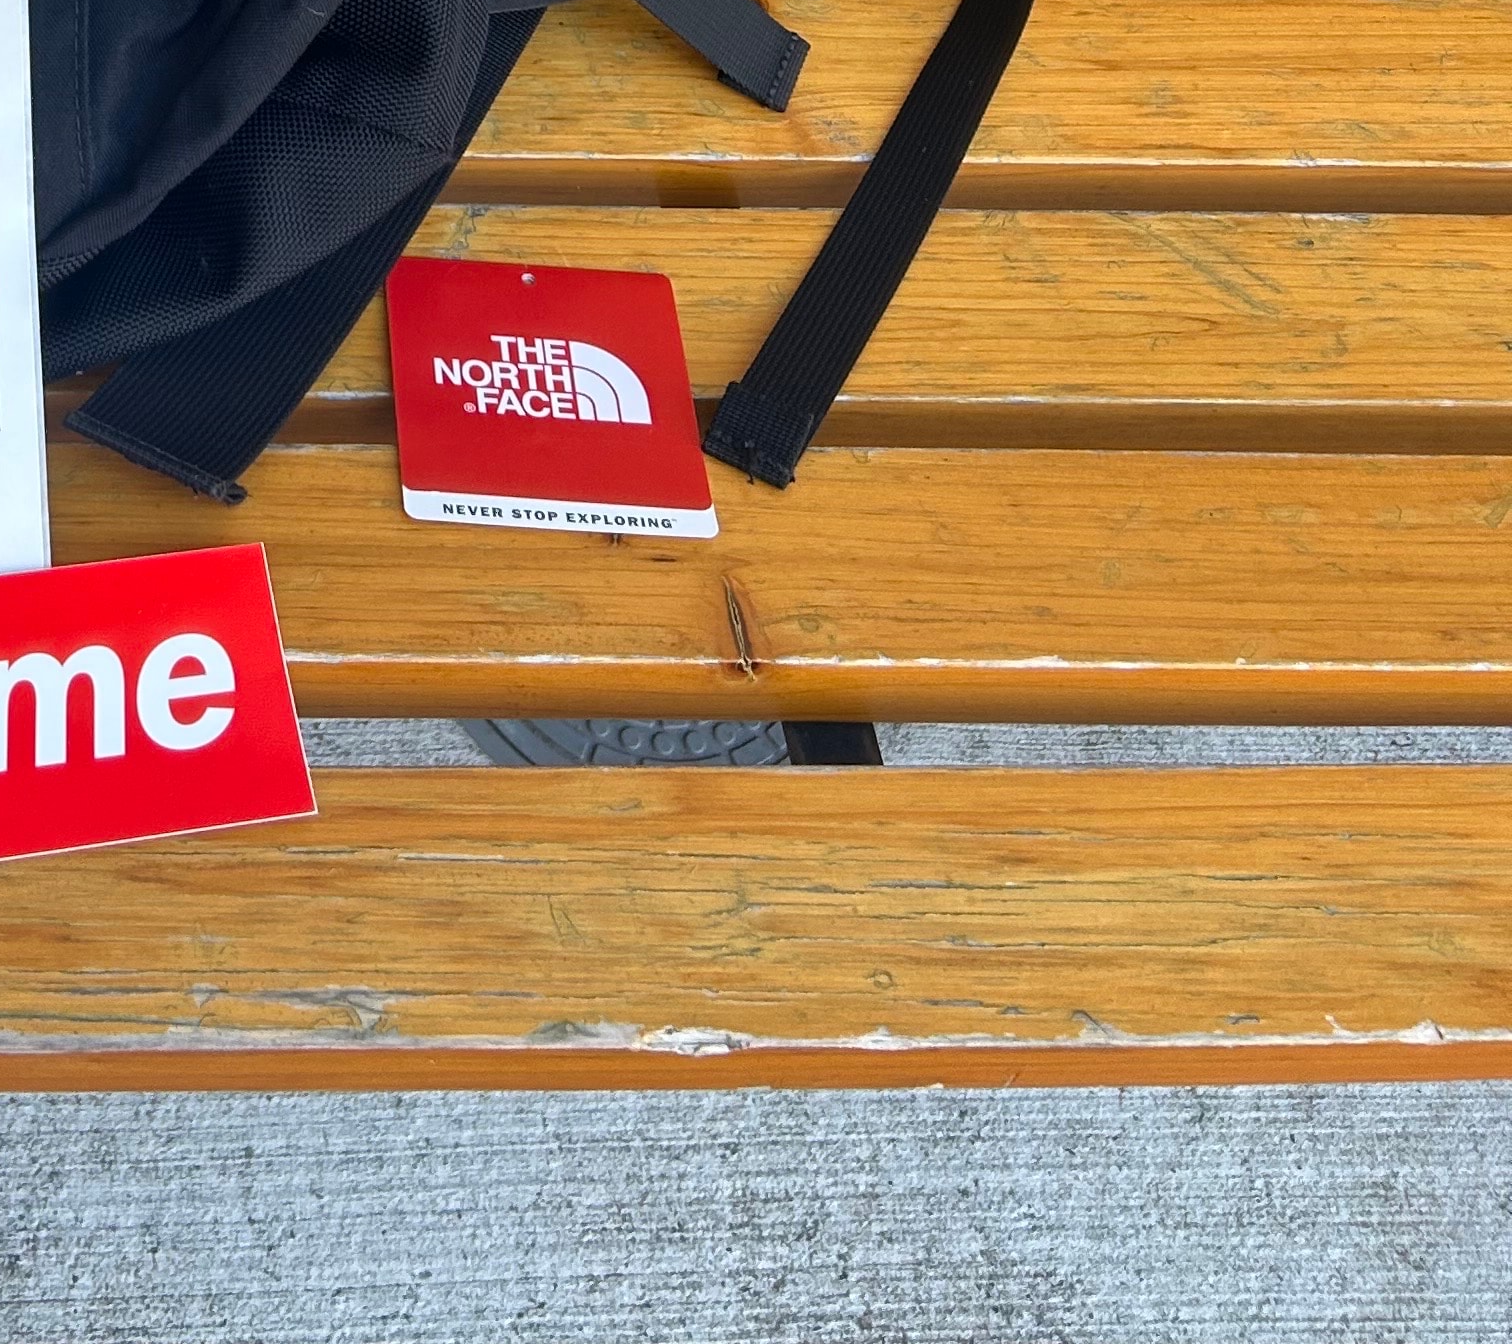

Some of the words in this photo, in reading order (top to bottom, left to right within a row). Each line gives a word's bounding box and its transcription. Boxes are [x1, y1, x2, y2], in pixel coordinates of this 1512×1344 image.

[490, 335, 568, 365] THE
[433, 357, 572, 392] NORTH
[476, 387, 576, 419] FACE
[443, 503, 503, 518] NEVER
[511, 508, 558, 522] STOP
